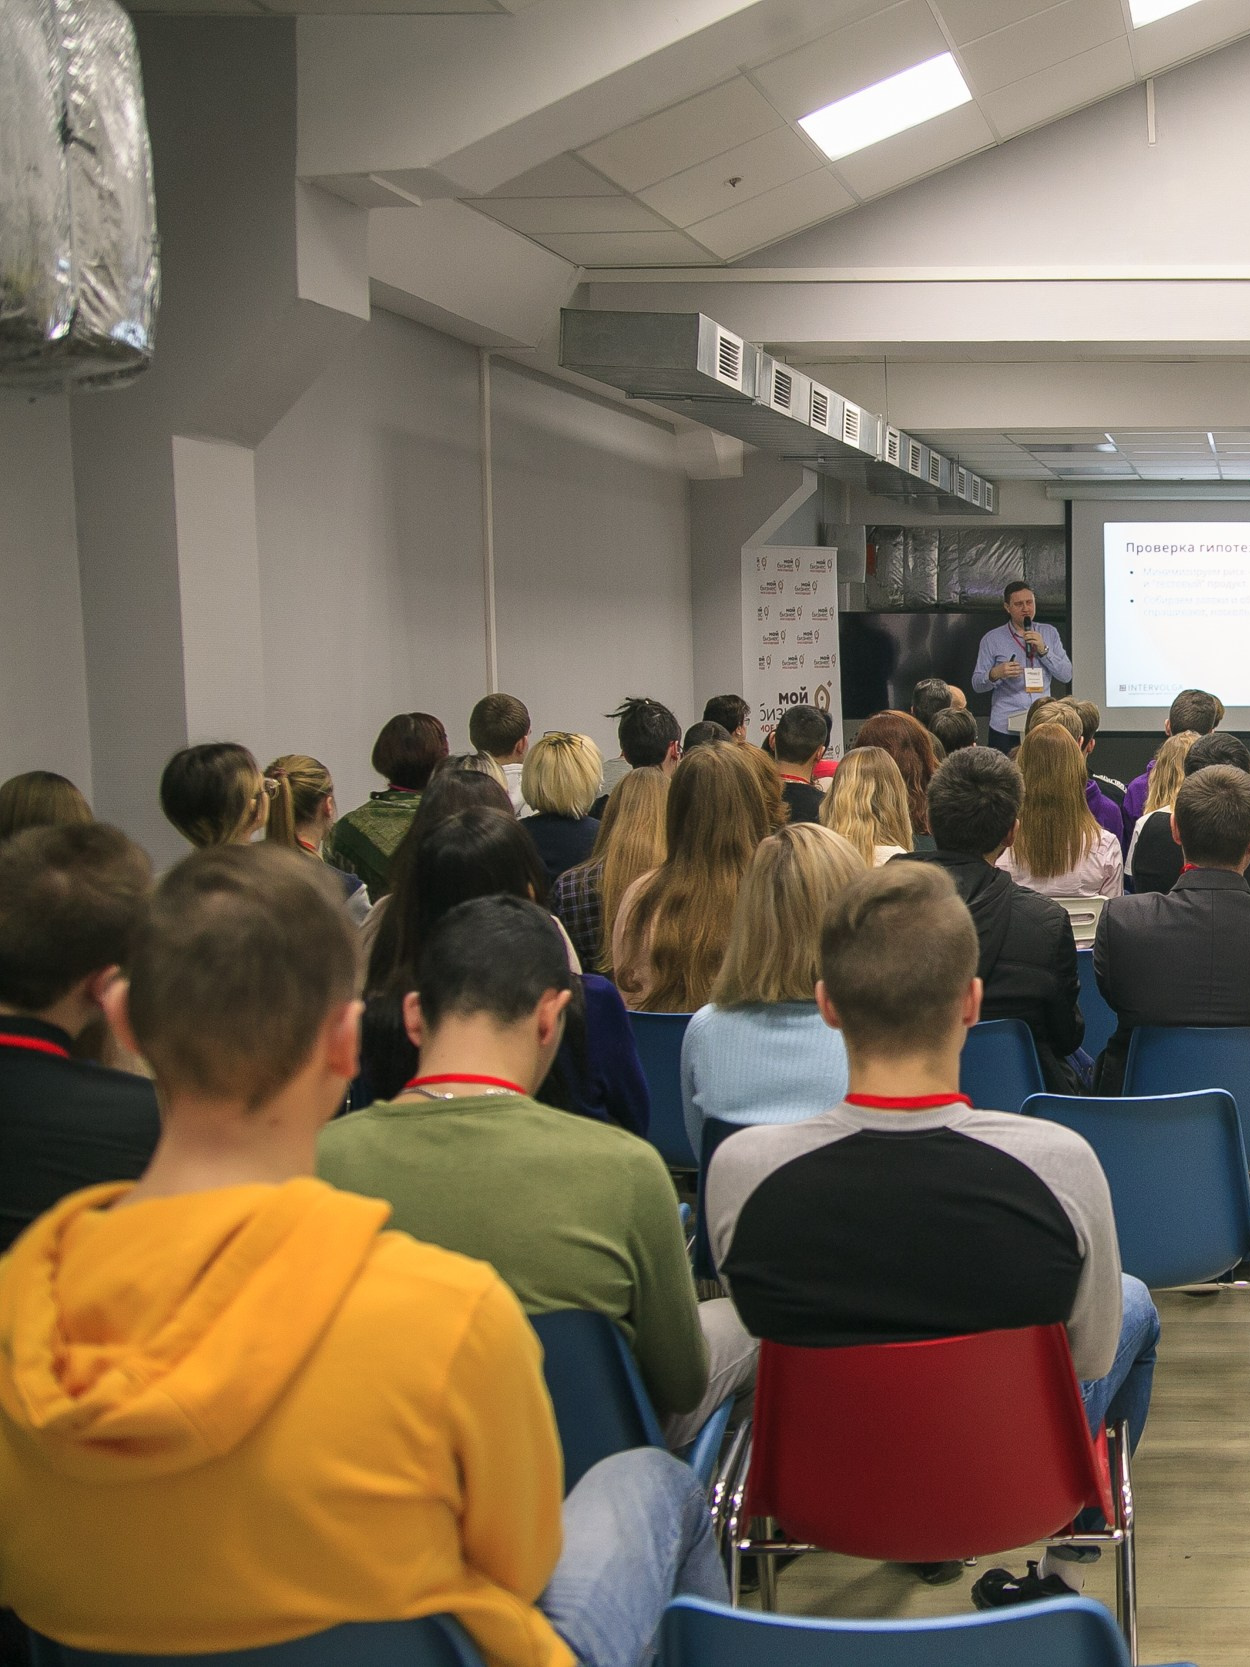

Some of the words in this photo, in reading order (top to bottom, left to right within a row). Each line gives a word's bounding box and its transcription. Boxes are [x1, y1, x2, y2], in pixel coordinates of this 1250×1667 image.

[1126, 542, 1195, 555] Проверка
[1128, 684, 1184, 692] INTERVOLGA
[779, 686, 808, 705] мой
